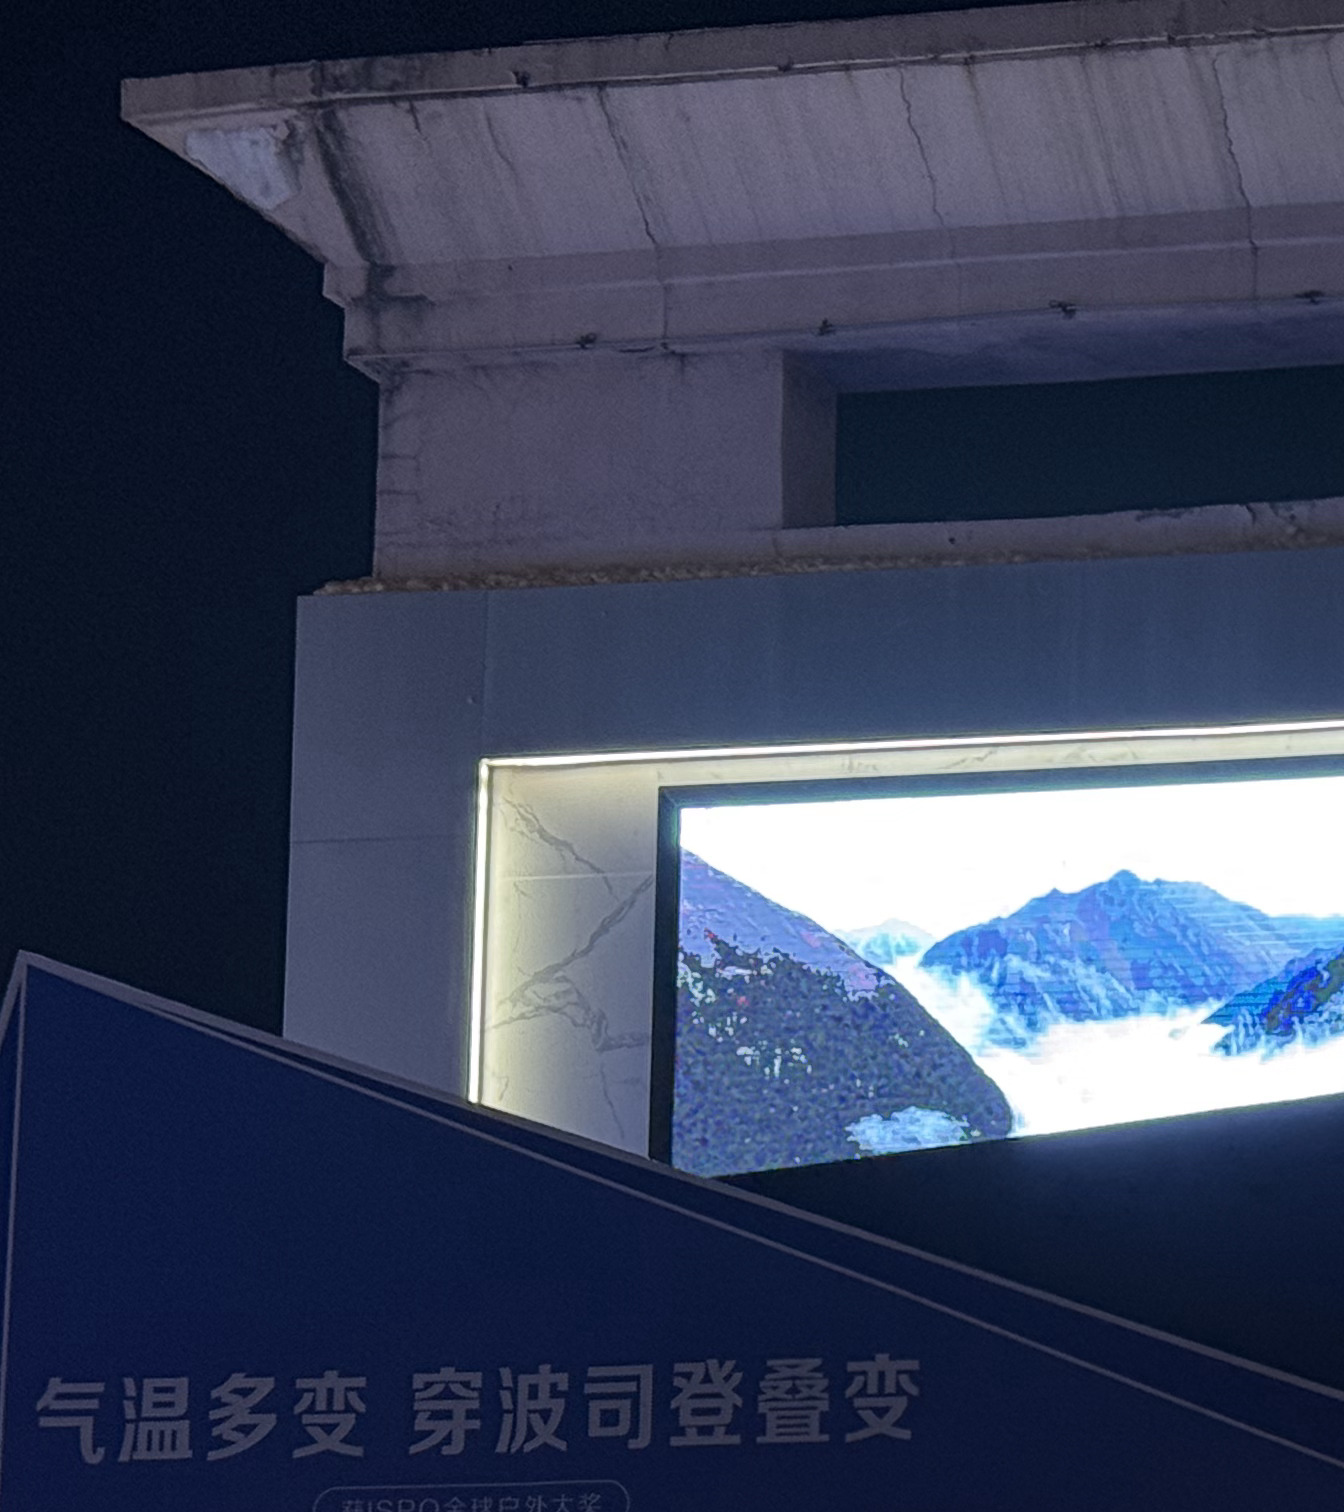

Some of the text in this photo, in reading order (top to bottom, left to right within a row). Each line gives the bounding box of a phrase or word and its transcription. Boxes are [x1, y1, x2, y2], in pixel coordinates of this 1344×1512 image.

[35, 1352, 922, 1466] 气温多变 穿波司登叠变
